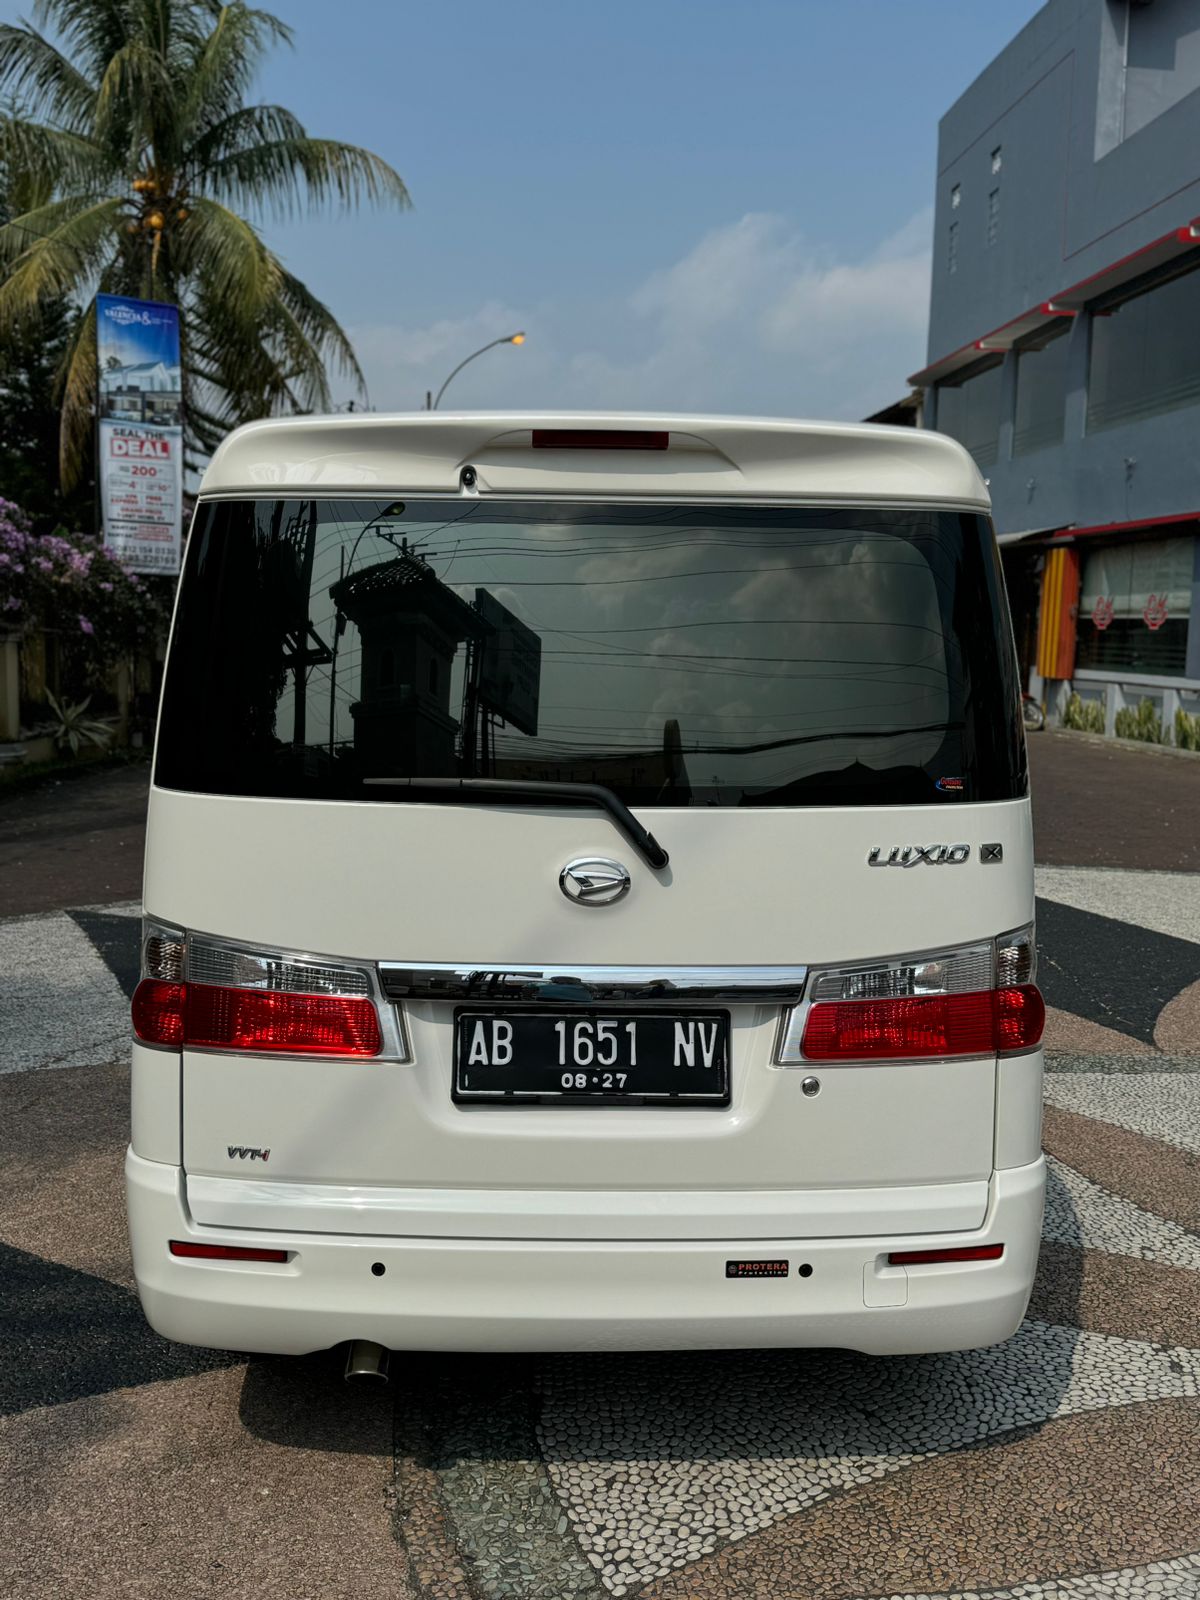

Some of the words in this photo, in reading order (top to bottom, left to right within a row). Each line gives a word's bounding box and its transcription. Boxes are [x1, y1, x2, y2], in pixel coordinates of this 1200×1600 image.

[113, 428, 141, 437] SEAL
[144, 431, 165, 439] THE
[112, 440, 170, 457] DEAL
[131, 465, 157, 477] 200
[868, 844, 970, 868] LUXIO
[983, 846, 1002, 861] X
[468, 1020, 513, 1066] AB
[554, 1021, 637, 1066] 1651
[673, 1022, 718, 1068] NV
